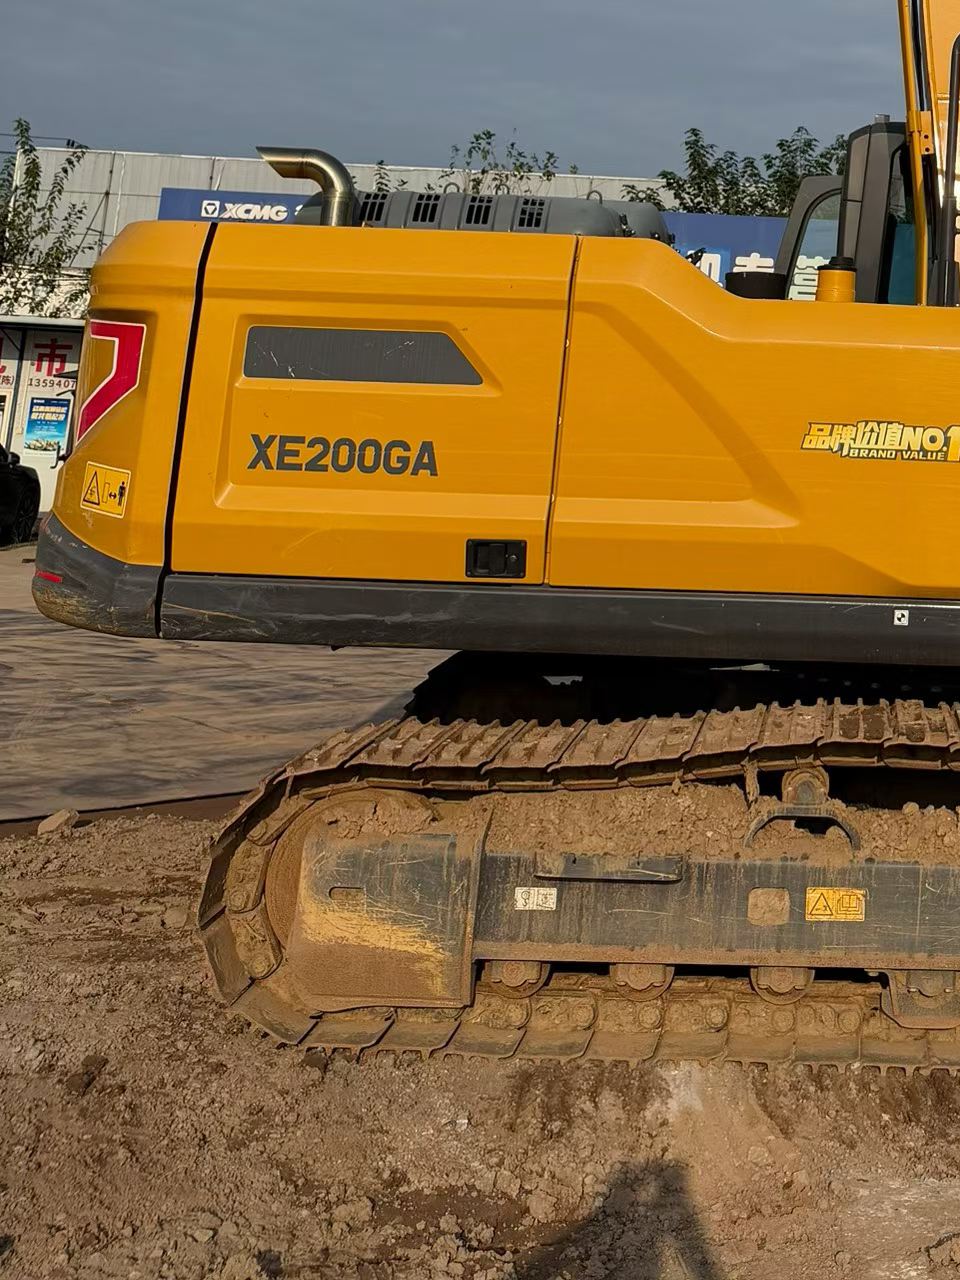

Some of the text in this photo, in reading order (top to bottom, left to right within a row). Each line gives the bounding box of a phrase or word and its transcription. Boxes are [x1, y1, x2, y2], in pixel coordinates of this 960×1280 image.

[219, 202, 288, 222] XCMG
[247, 433, 439, 477] XE200GA
[849, 448, 945, 461] BRAND VALUE
